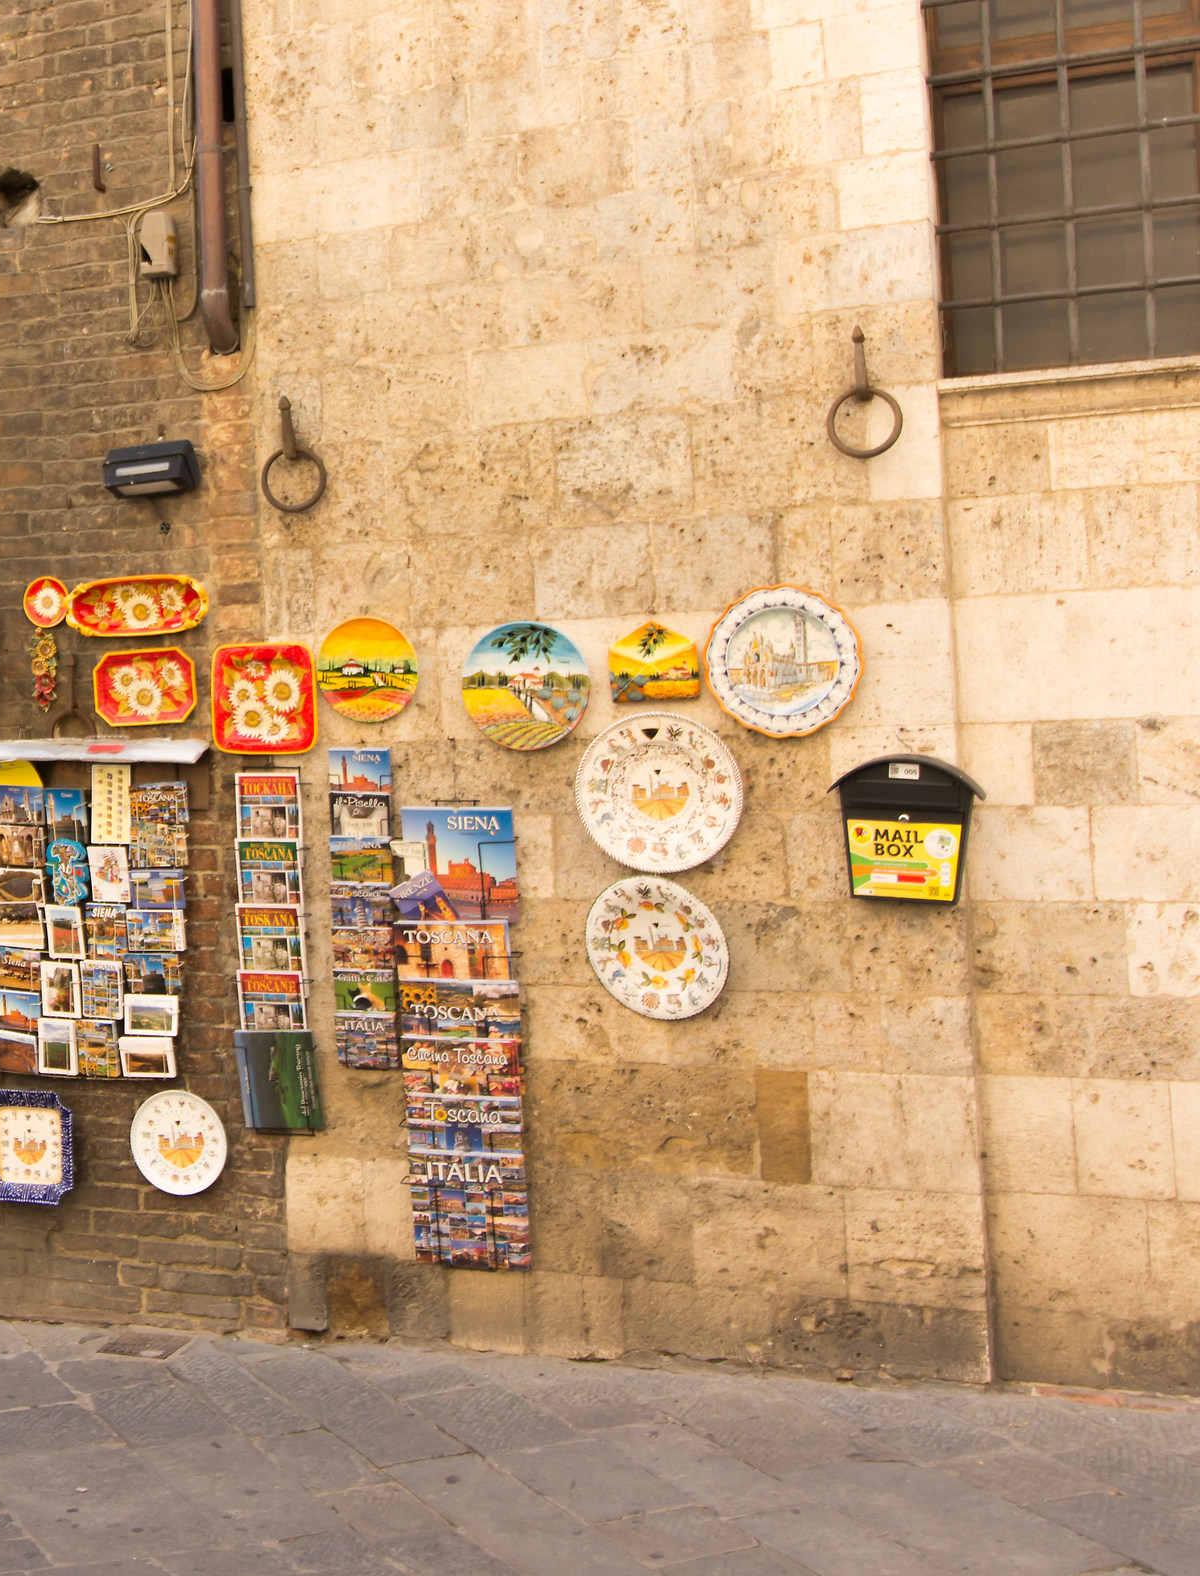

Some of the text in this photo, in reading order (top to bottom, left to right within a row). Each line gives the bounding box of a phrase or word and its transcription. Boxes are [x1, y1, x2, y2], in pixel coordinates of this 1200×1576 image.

[138, 794, 176, 802] TOSCANA
[347, 797, 385, 808] Pisello
[447, 815, 500, 831] SIENA
[874, 828, 924, 844] MAIL
[337, 841, 382, 849] TOSCANA
[874, 843, 914, 857] BOX
[243, 847, 294, 861] TOSCANA
[338, 888, 382, 899] Toscana
[394, 875, 433, 902] FIRENZE
[92, 907, 117, 918] SIENA
[242, 913, 295, 927] TOSKANA
[403, 930, 494, 944] TOSCANA
[2, 954, 26, 967] Siena
[245, 979, 297, 993] TOSCANE
[410, 1004, 501, 1022] TOSCANA
[345, 1021, 385, 1032] ITALIA
[407, 1047, 508, 1065] Cucina Toscana
[424, 1101, 502, 1124] Toscana
[426, 1162, 502, 1184] ITALIA
